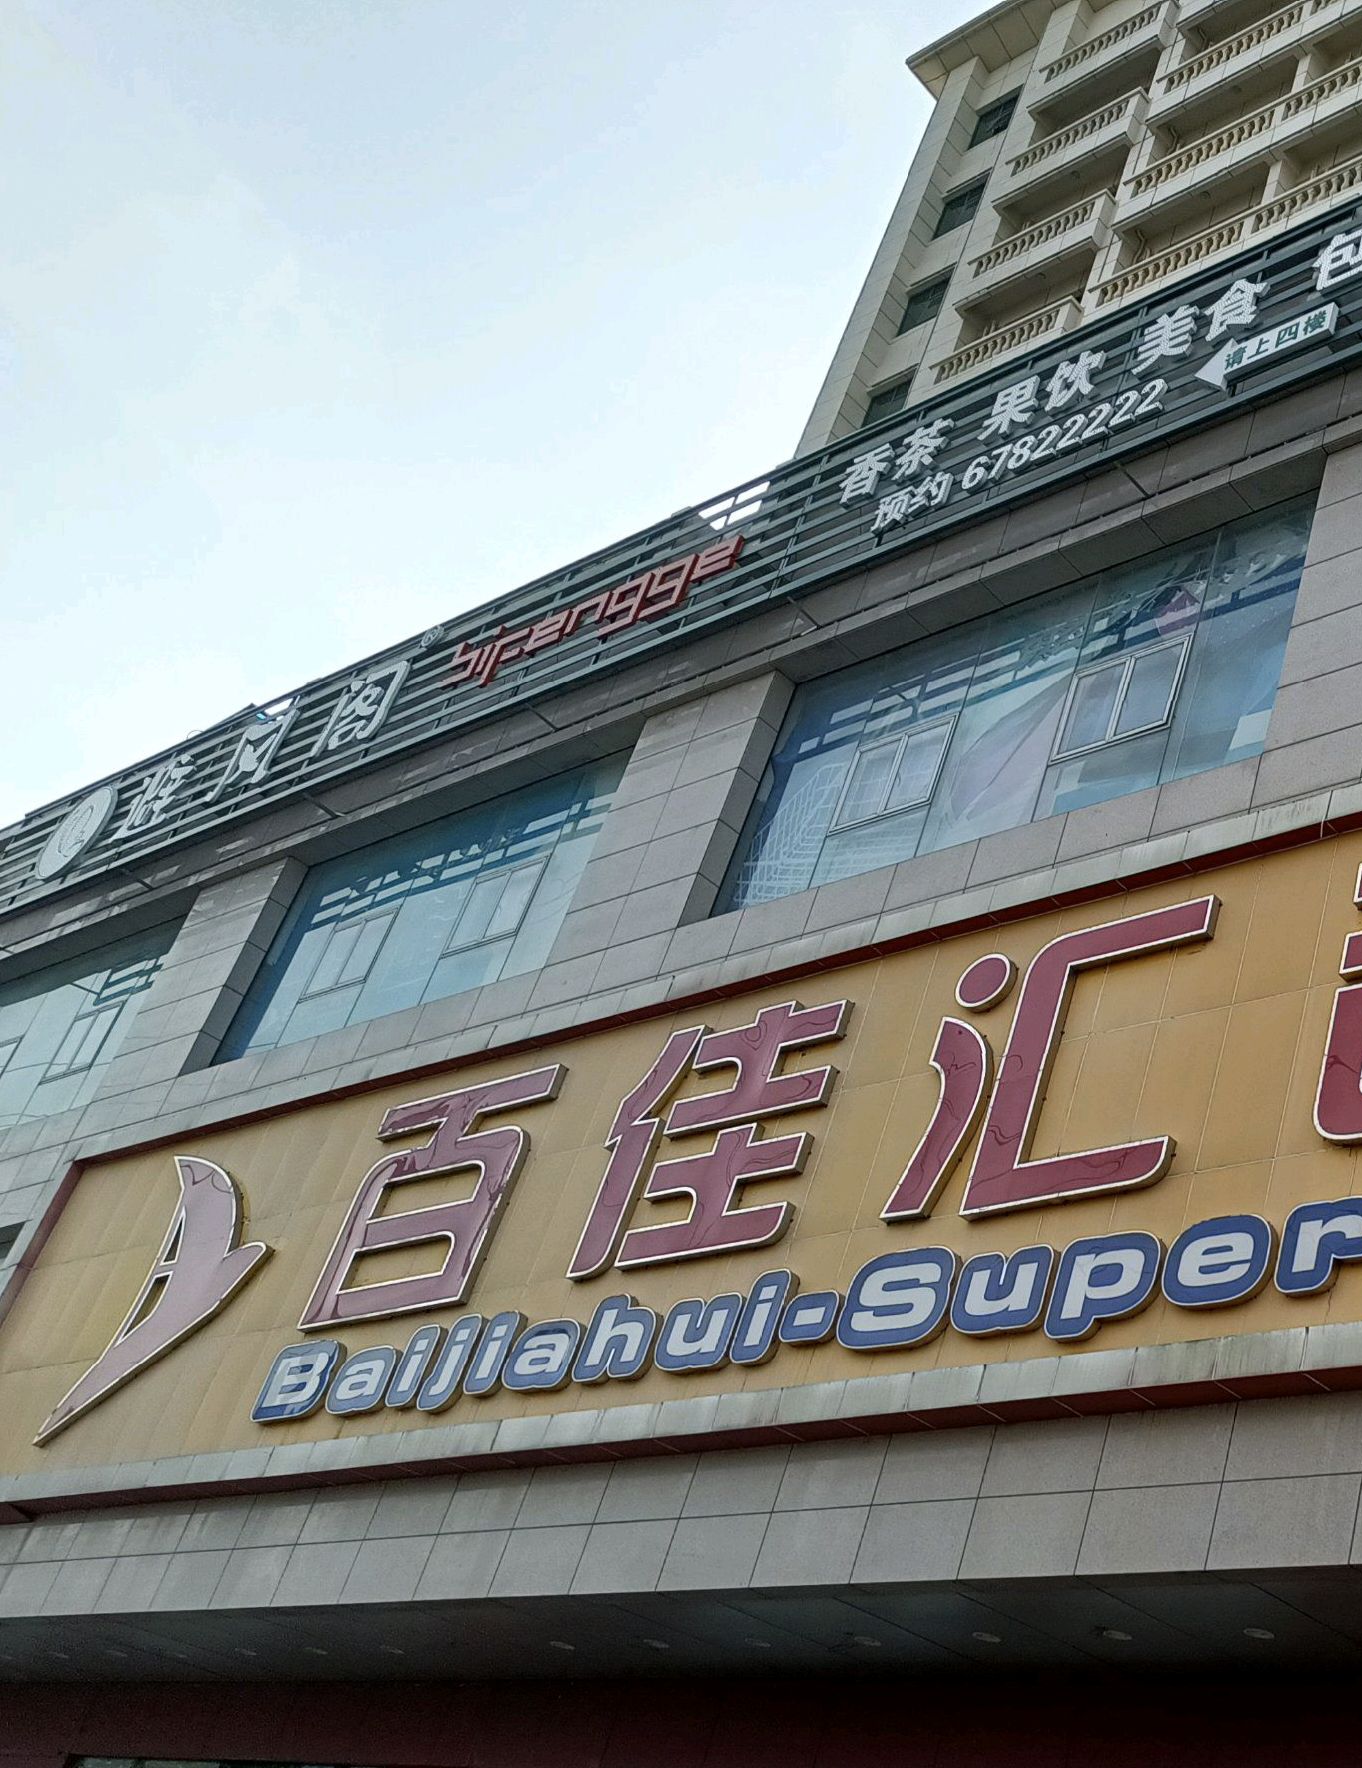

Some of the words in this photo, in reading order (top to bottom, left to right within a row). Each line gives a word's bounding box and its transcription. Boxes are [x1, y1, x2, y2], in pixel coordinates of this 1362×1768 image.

[838, 416, 955, 508] 香茶
[976, 349, 1107, 442] 果饮
[1131, 278, 1271, 377] 美食
[1223, 308, 1327, 371] 请上四楼
[870, 470, 955, 536] 预约
[960, 377, 1169, 493] 67822222
